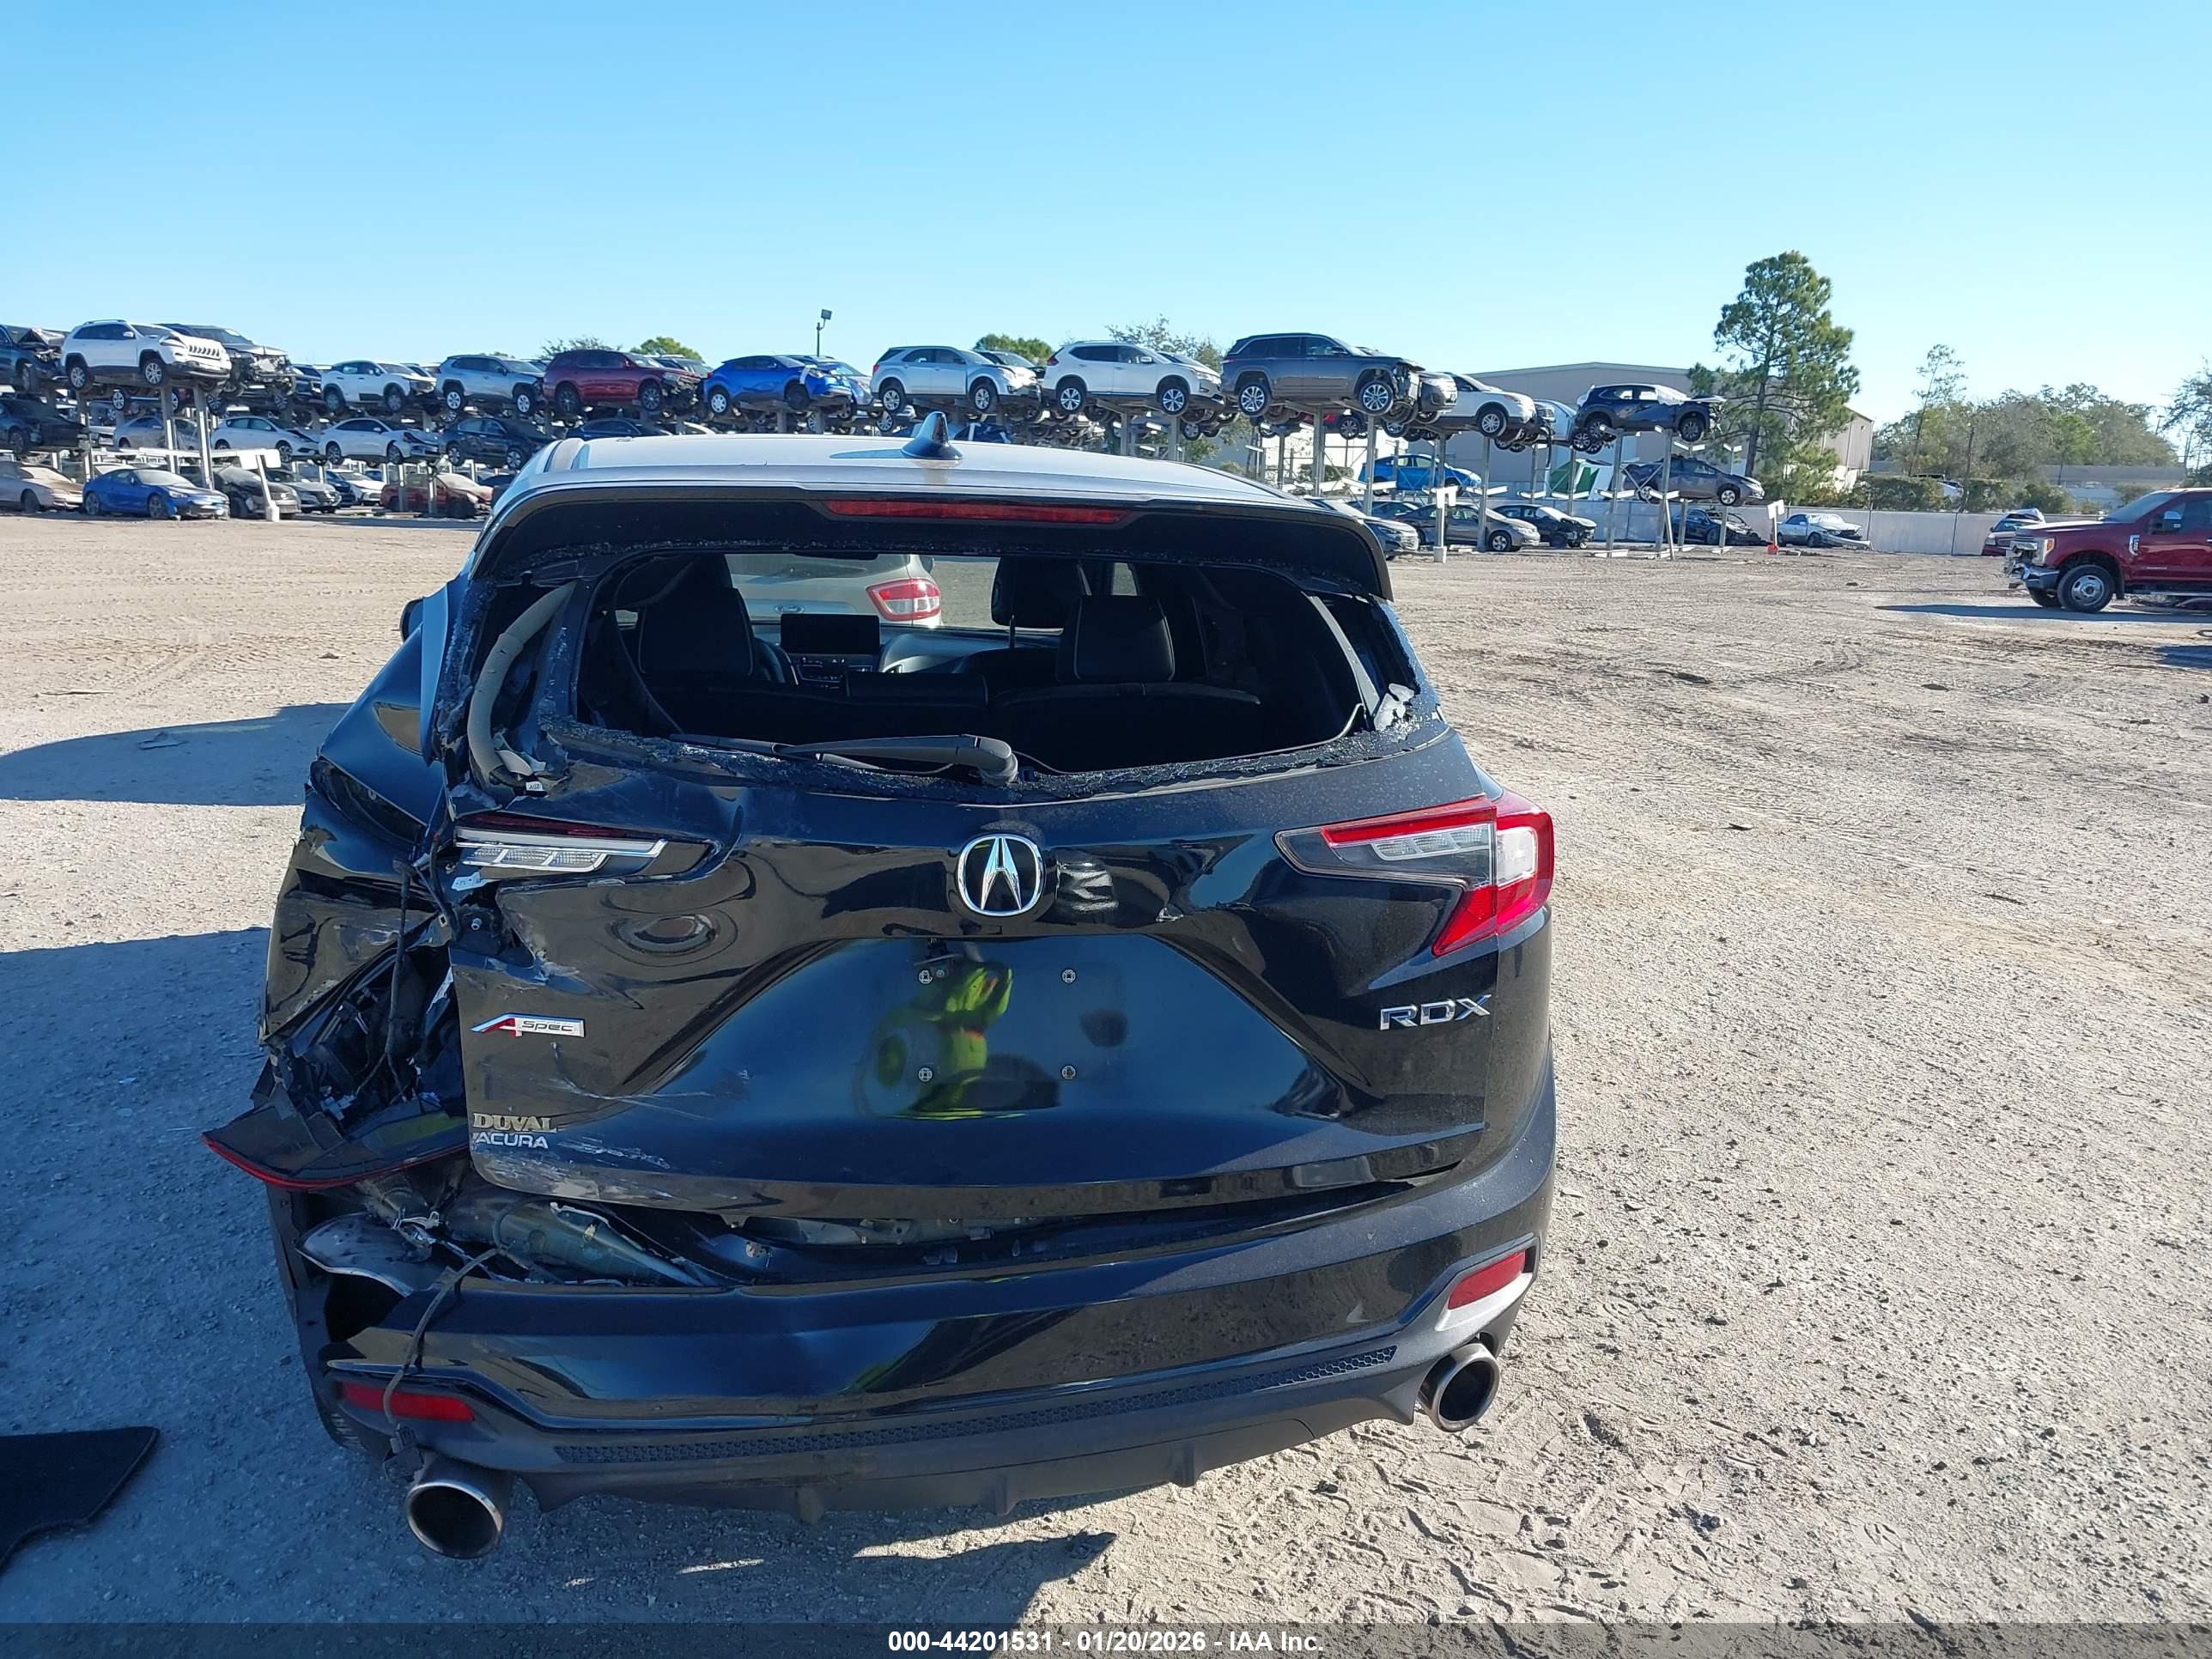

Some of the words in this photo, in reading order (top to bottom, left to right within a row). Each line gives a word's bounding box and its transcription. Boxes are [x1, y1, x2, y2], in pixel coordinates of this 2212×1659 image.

[1379, 994, 1492, 1030] RDX
[472, 1112, 557, 1133] DUVAL
[476, 1131, 550, 1149] ACURA
